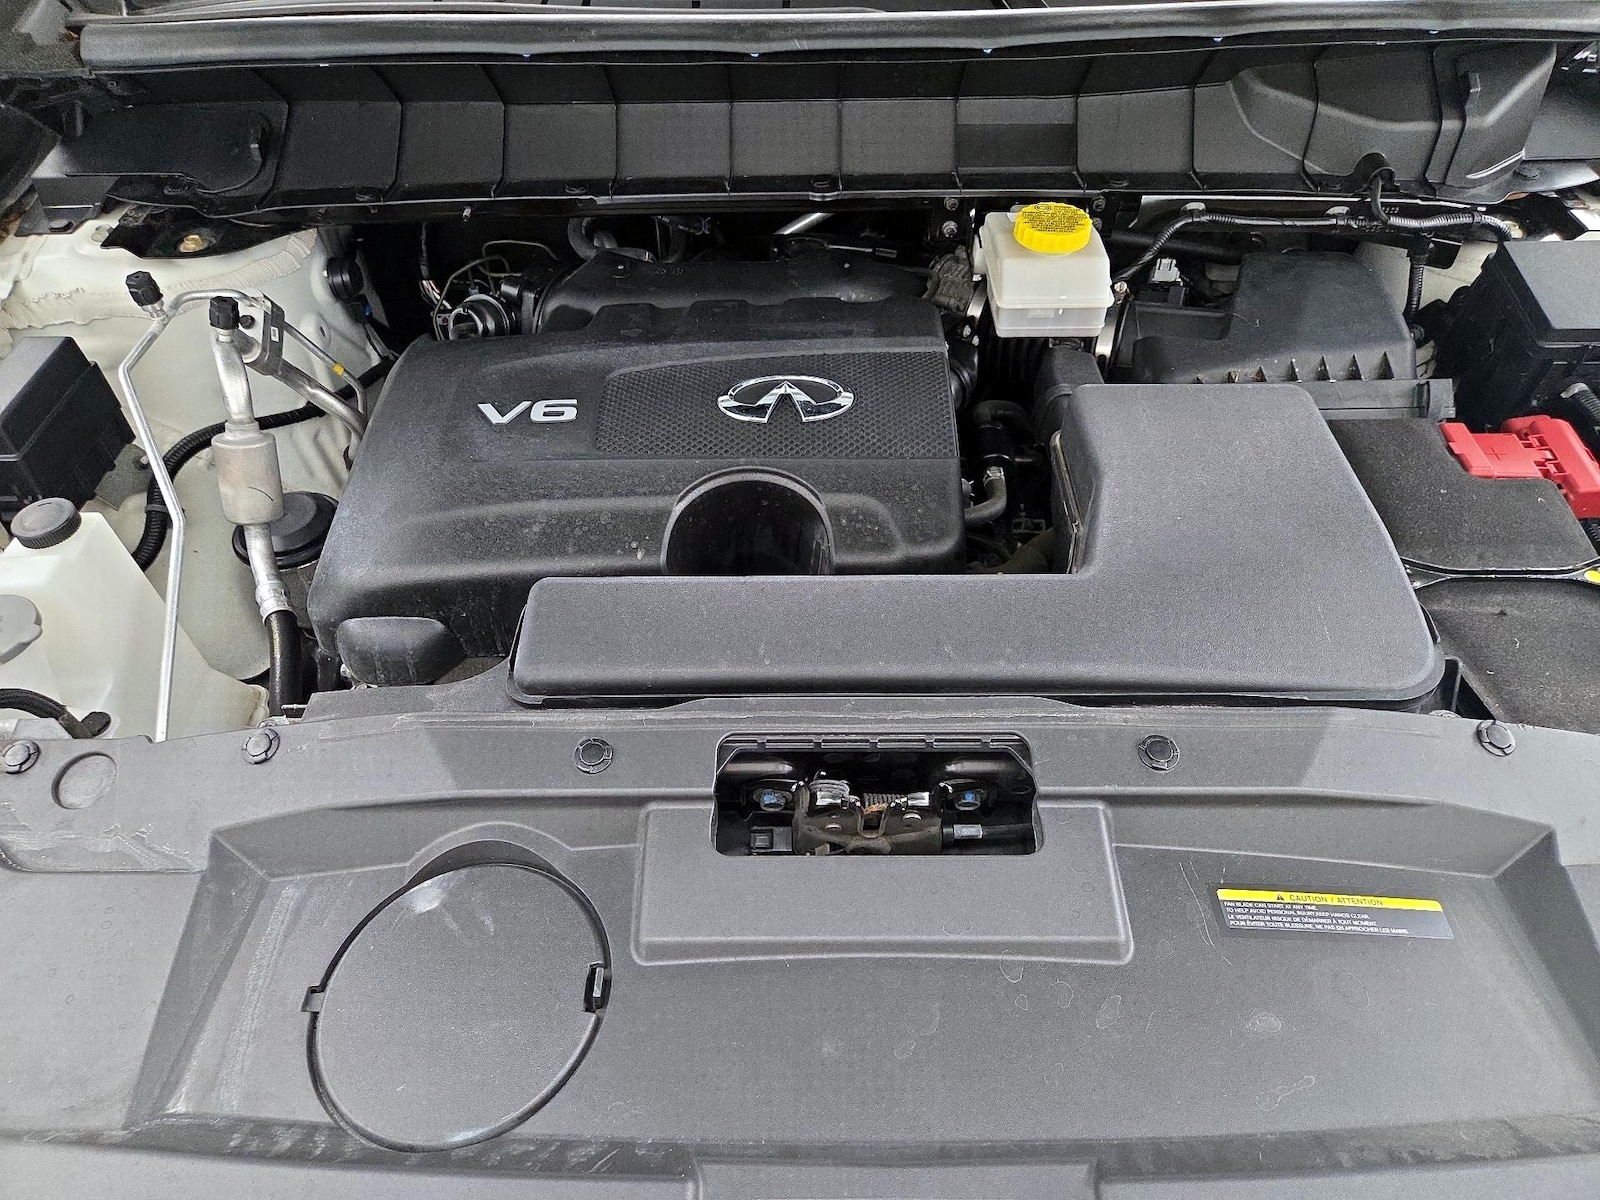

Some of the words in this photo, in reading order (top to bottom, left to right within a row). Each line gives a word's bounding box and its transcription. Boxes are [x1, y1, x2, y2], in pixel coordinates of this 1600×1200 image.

[478, 399, 578, 425] V6
[1290, 894, 1328, 903] CAUTION
[1337, 897, 1384, 906] ATTENTION
